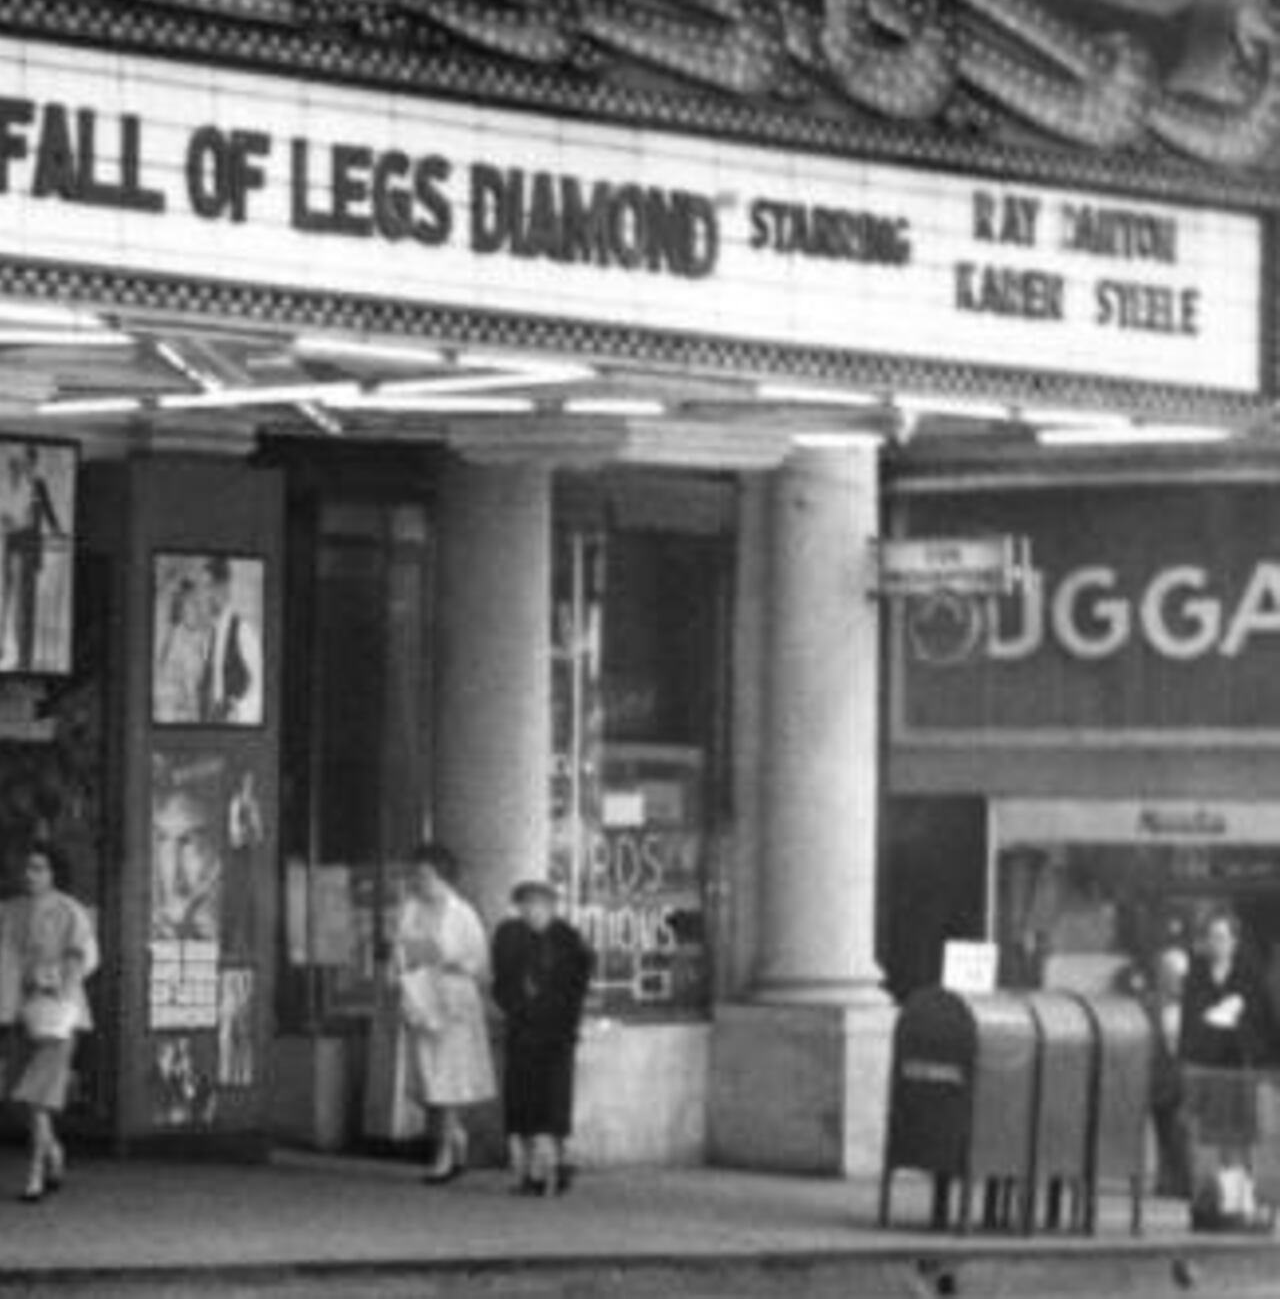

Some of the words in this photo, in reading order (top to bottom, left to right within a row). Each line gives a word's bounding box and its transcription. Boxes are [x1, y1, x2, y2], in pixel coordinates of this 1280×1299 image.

[184, 123, 272, 226] OF
[290, 137, 452, 245] LEGS
[972, 189, 1041, 248] RAY
[953, 260, 1065, 322] KAREN
[1094, 277, 1202, 339] STEELE
